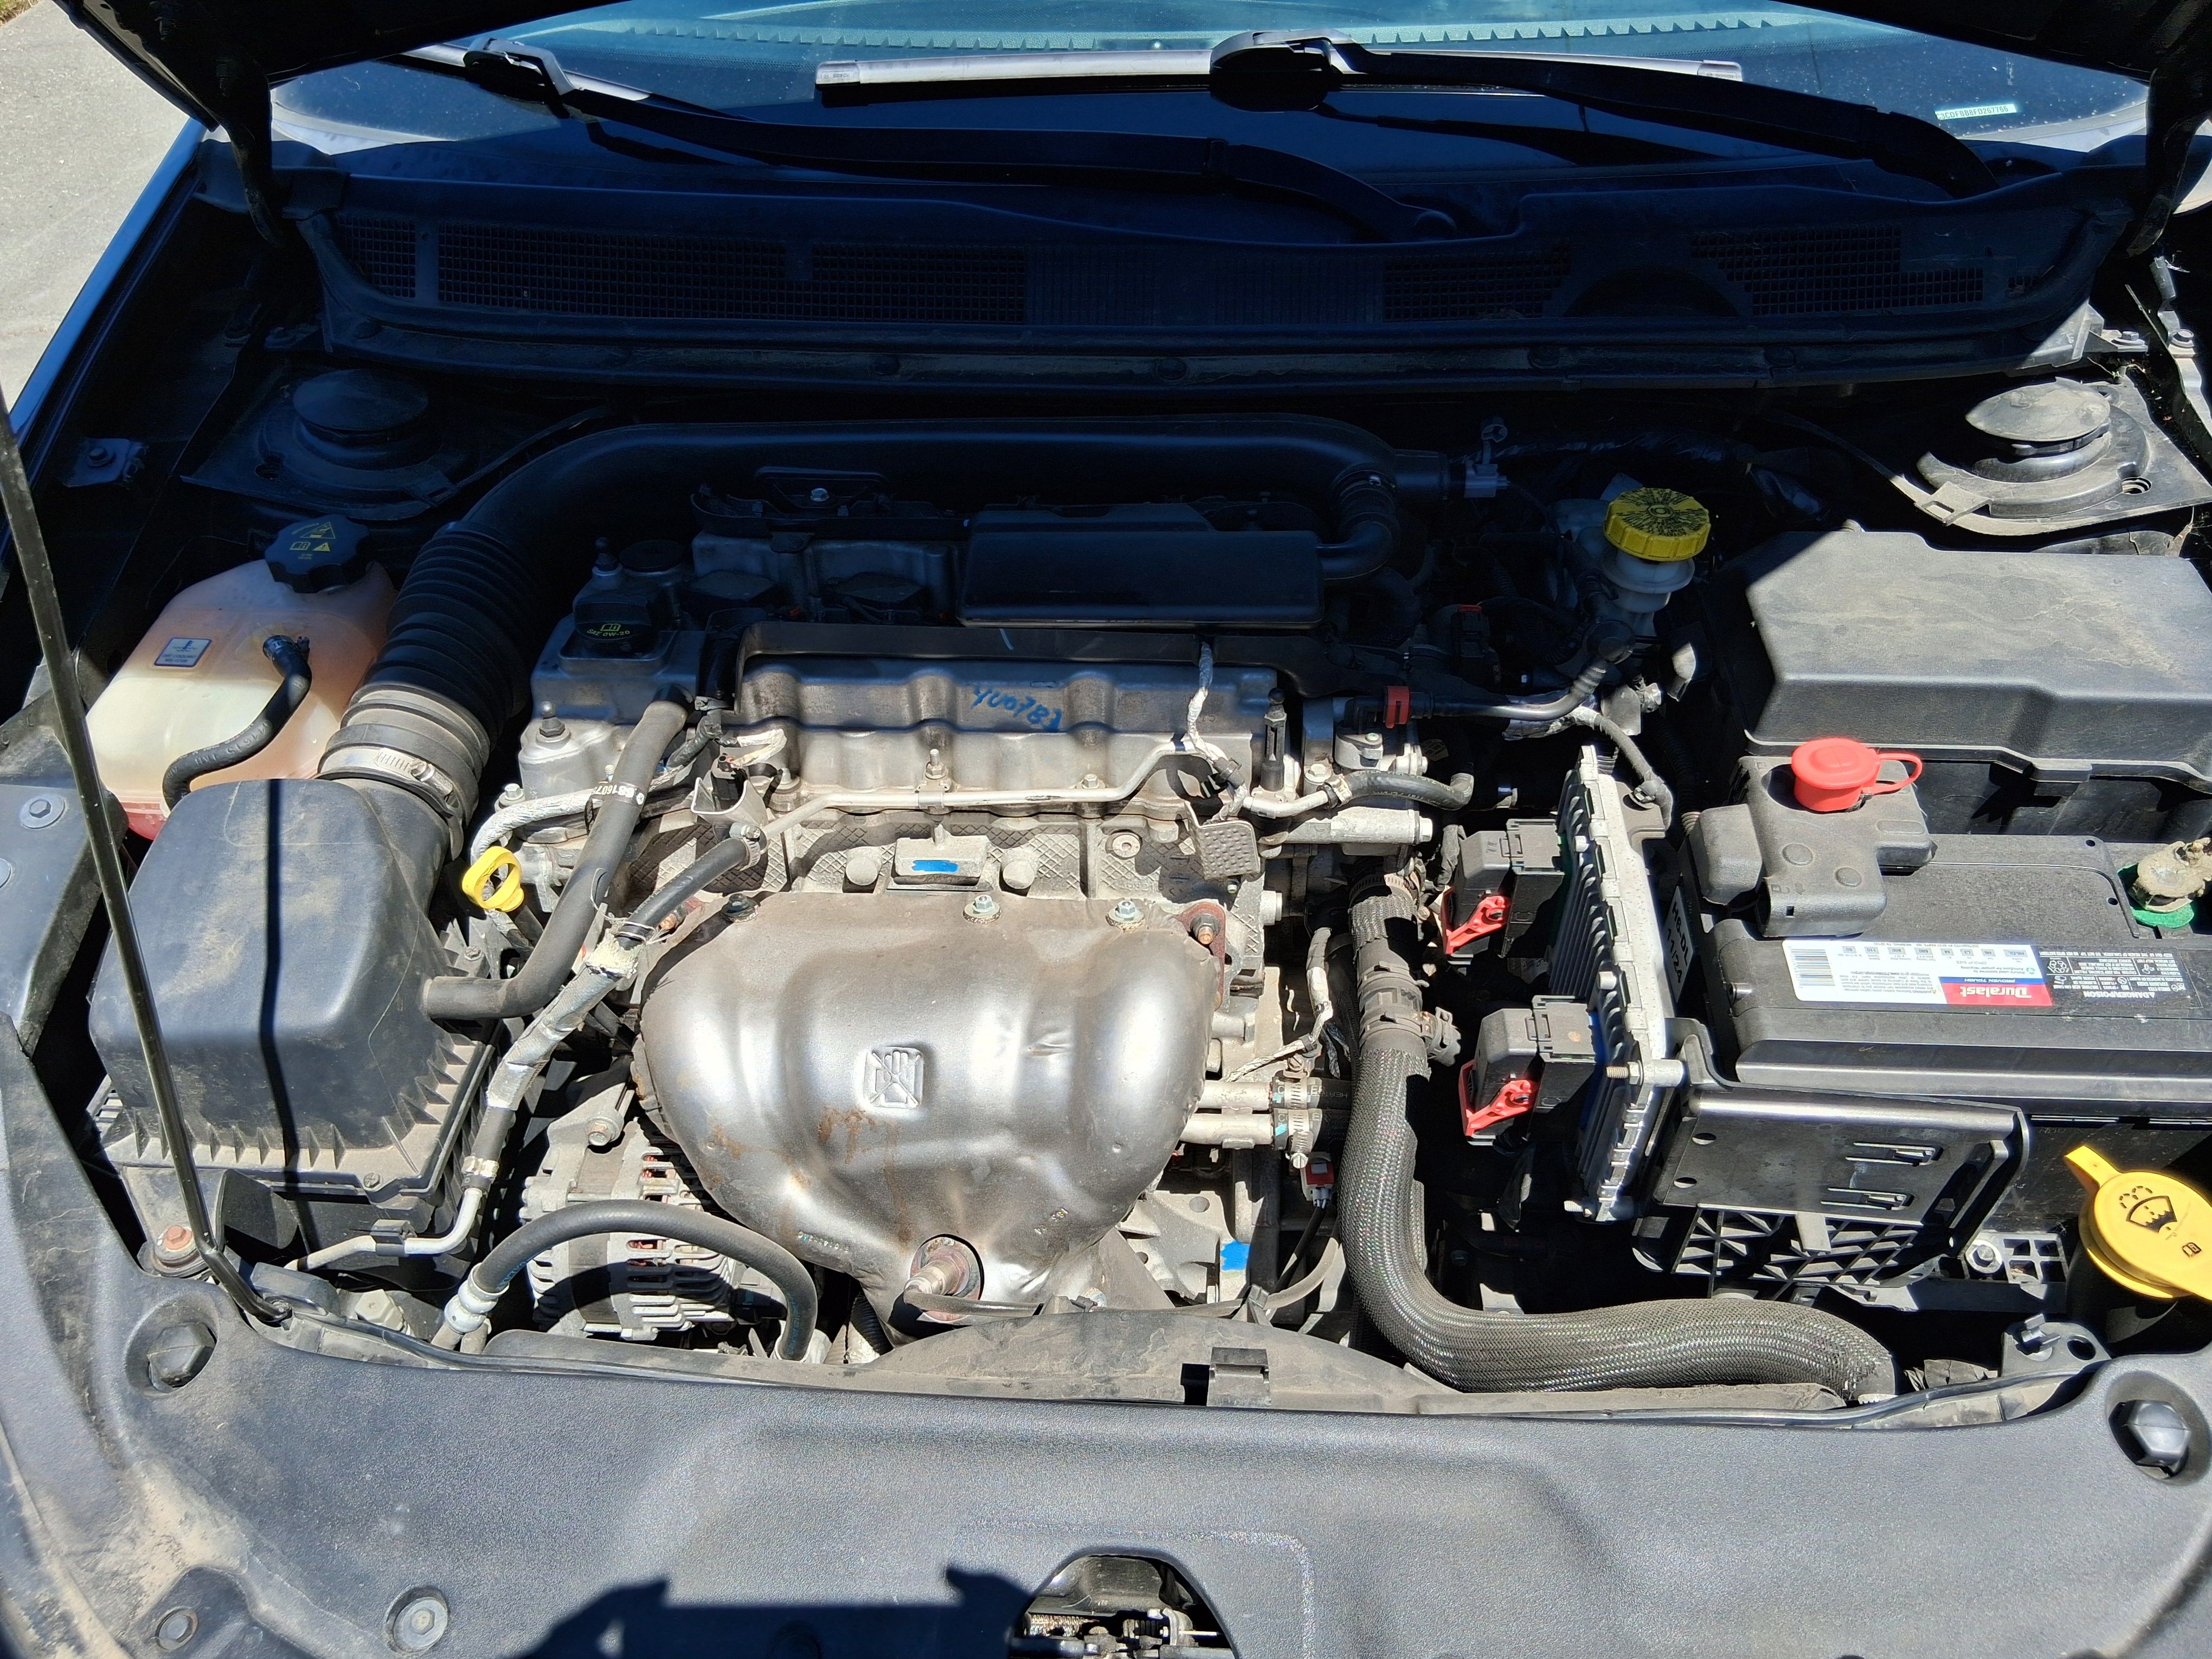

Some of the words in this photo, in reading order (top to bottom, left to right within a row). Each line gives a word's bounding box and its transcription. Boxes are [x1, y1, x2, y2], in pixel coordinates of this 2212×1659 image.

[1668, 928, 1683, 983] 11/24
[1672, 902, 1689, 966] H6-DL
[1959, 986, 2032, 998] Duralast
